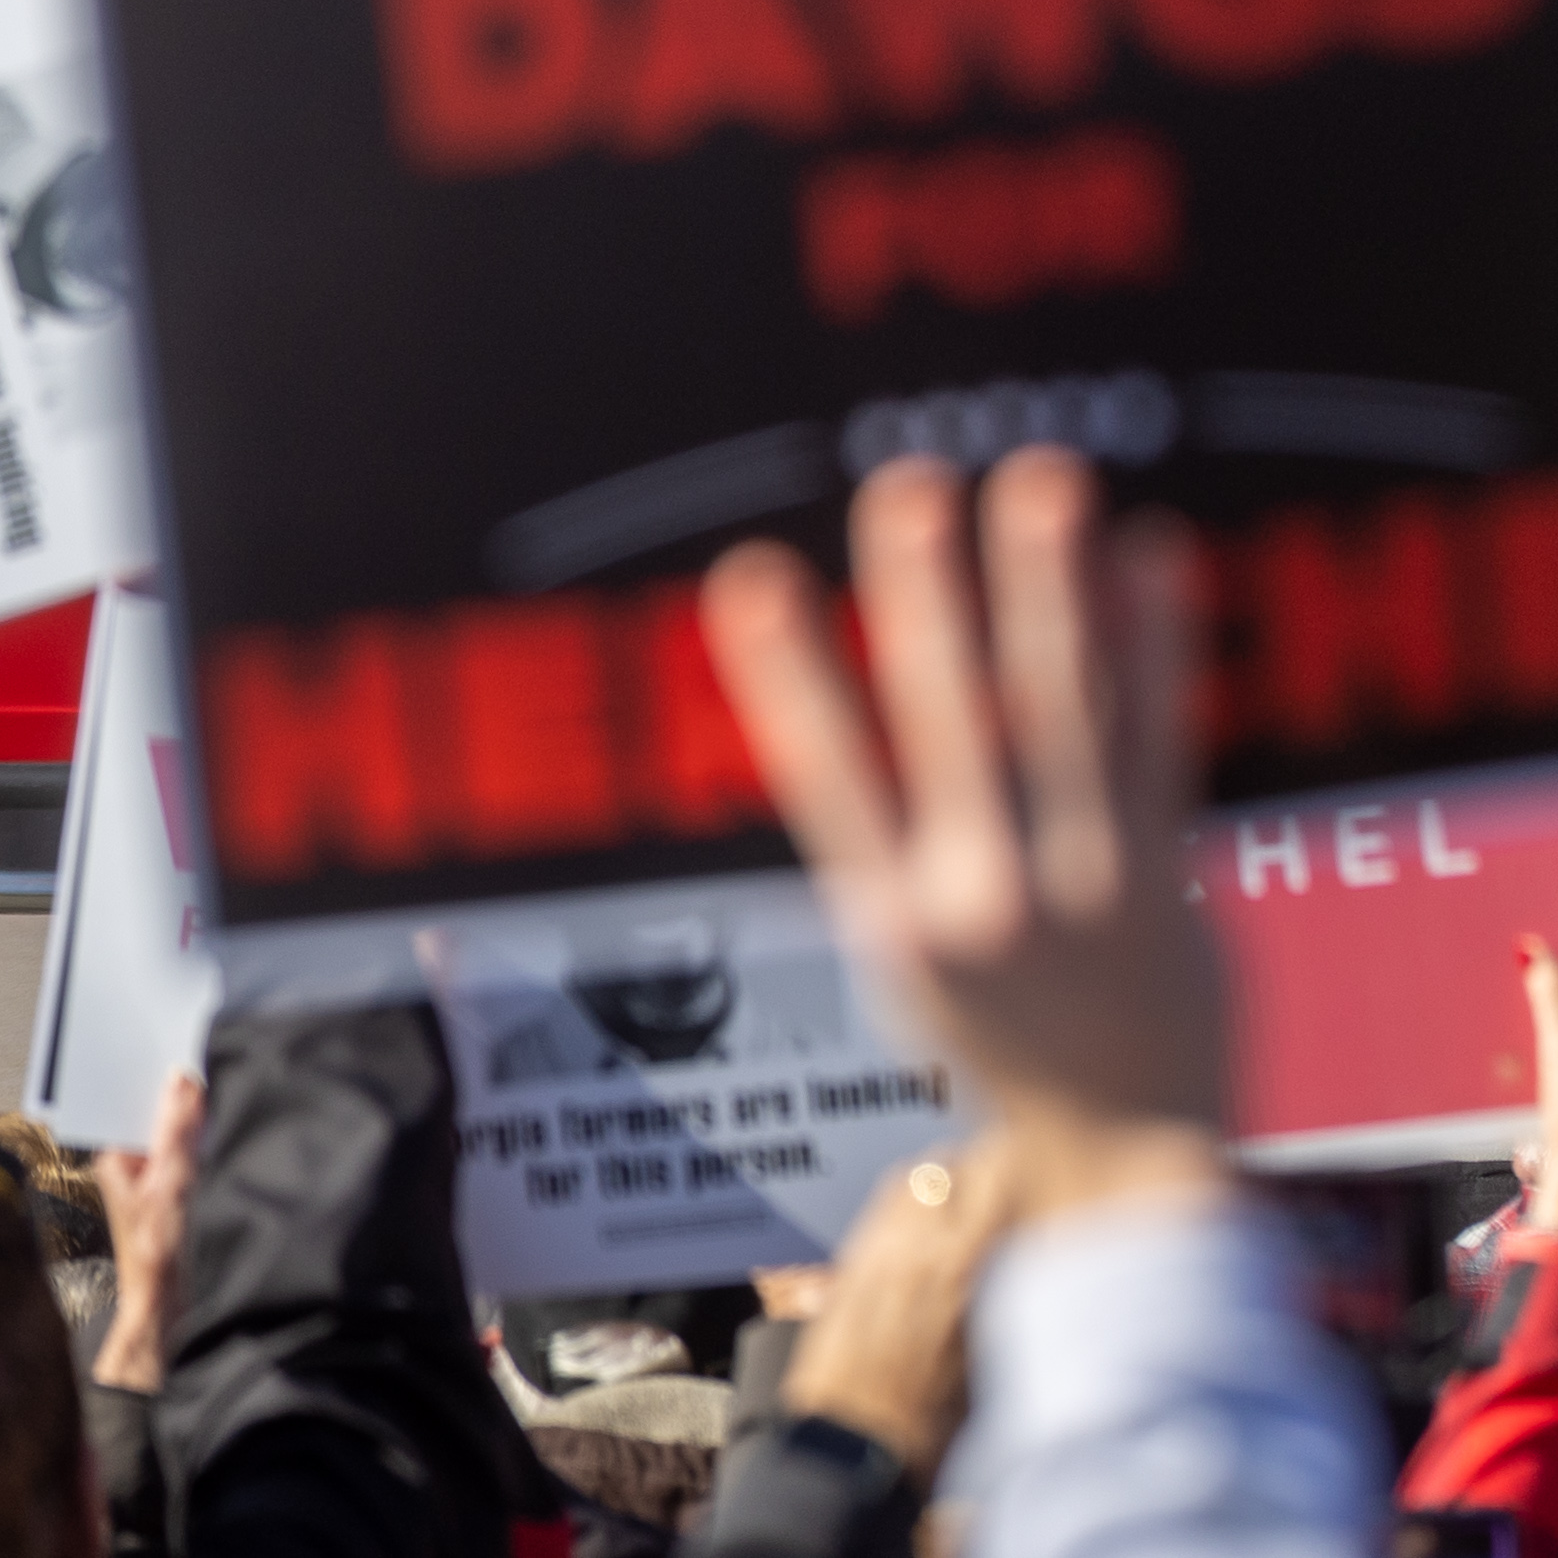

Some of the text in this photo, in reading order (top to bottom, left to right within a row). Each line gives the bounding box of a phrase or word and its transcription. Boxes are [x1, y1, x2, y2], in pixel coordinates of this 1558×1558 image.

[805, 127, 1180, 317] FOR
[1184, 797, 1482, 901] HEL
[456, 1066, 951, 1160] rgia farmers are looking
[529, 1165, 582, 1204] for
[601, 1153, 668, 1197] this
